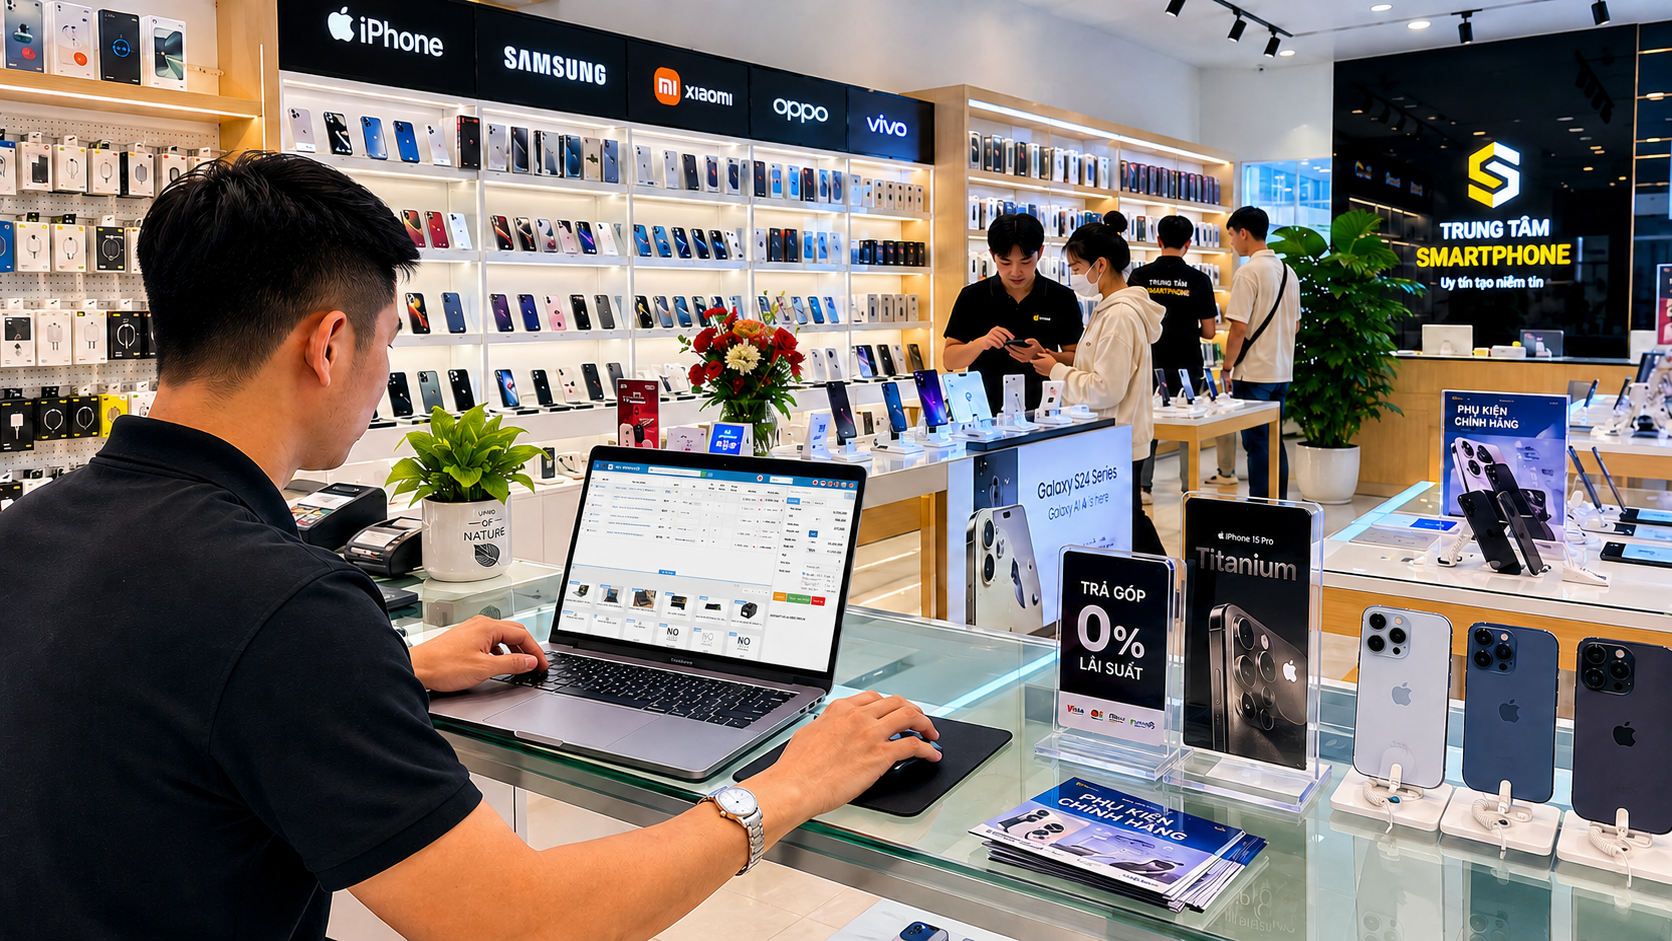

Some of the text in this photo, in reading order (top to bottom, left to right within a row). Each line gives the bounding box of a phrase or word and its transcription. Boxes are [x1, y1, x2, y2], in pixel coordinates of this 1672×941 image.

[360, 16, 444, 57] iPhone
[503, 46, 607, 86] SAMSUNG
[684, 84, 733, 107] xiaomi
[773, 97, 829, 124] oppo
[866, 114, 908, 137] vivo
[1439, 215, 1550, 239] TRUNG TÂM
[1416, 243, 1572, 267] SMARTPHONE
[1440, 276, 1456, 291] Uy
[1457, 405, 1508, 418] PHỤ KIỆN
[1037, 465, 1118, 499] Galaxy S24 Series
[481, 518, 493, 527] OF
[1048, 504, 1073, 520] Galaxy
[463, 526, 505, 541] NATURE
[1225, 532, 1274, 545] iPhone 15 Pro
[1195, 546, 1297, 581] Titanium
[1080, 580, 1146, 603] TRẢ GÓP
[666, 627, 679, 637] NO
[737, 636, 751, 646] NO
[1077, 604, 1145, 659] 0%
[1079, 793, 1125, 812] PHỤ
